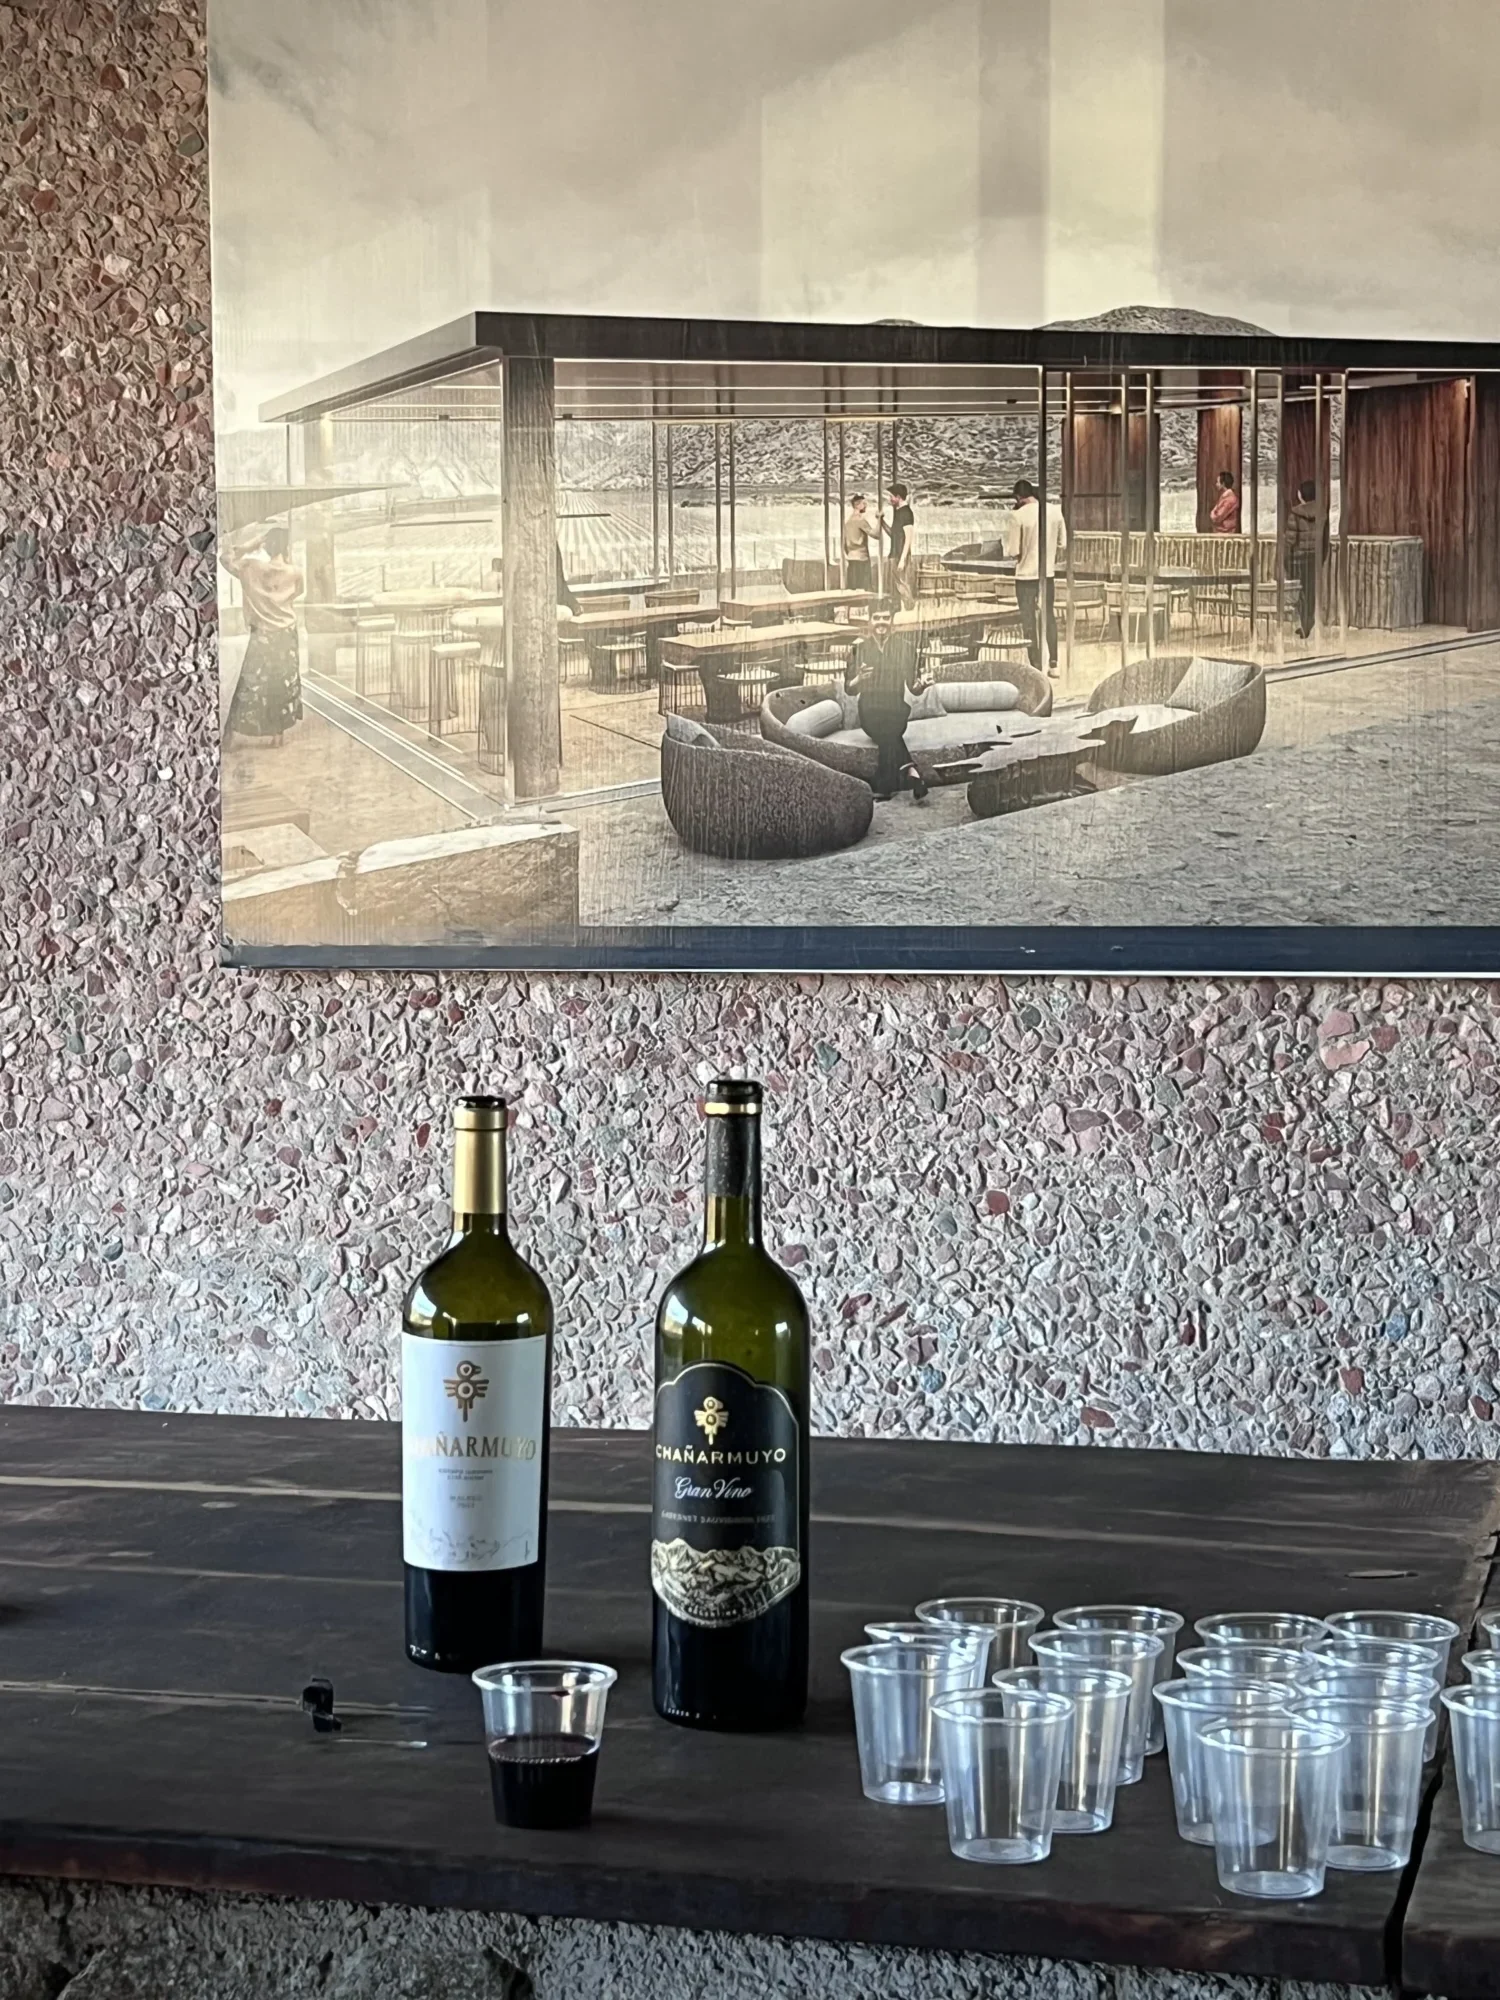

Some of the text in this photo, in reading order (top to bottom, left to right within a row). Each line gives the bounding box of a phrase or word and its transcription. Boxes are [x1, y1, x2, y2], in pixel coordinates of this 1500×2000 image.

[655, 1444, 787, 1464] CHAÑARMUYO
[674, 1476, 753, 1500] Gran Vino
